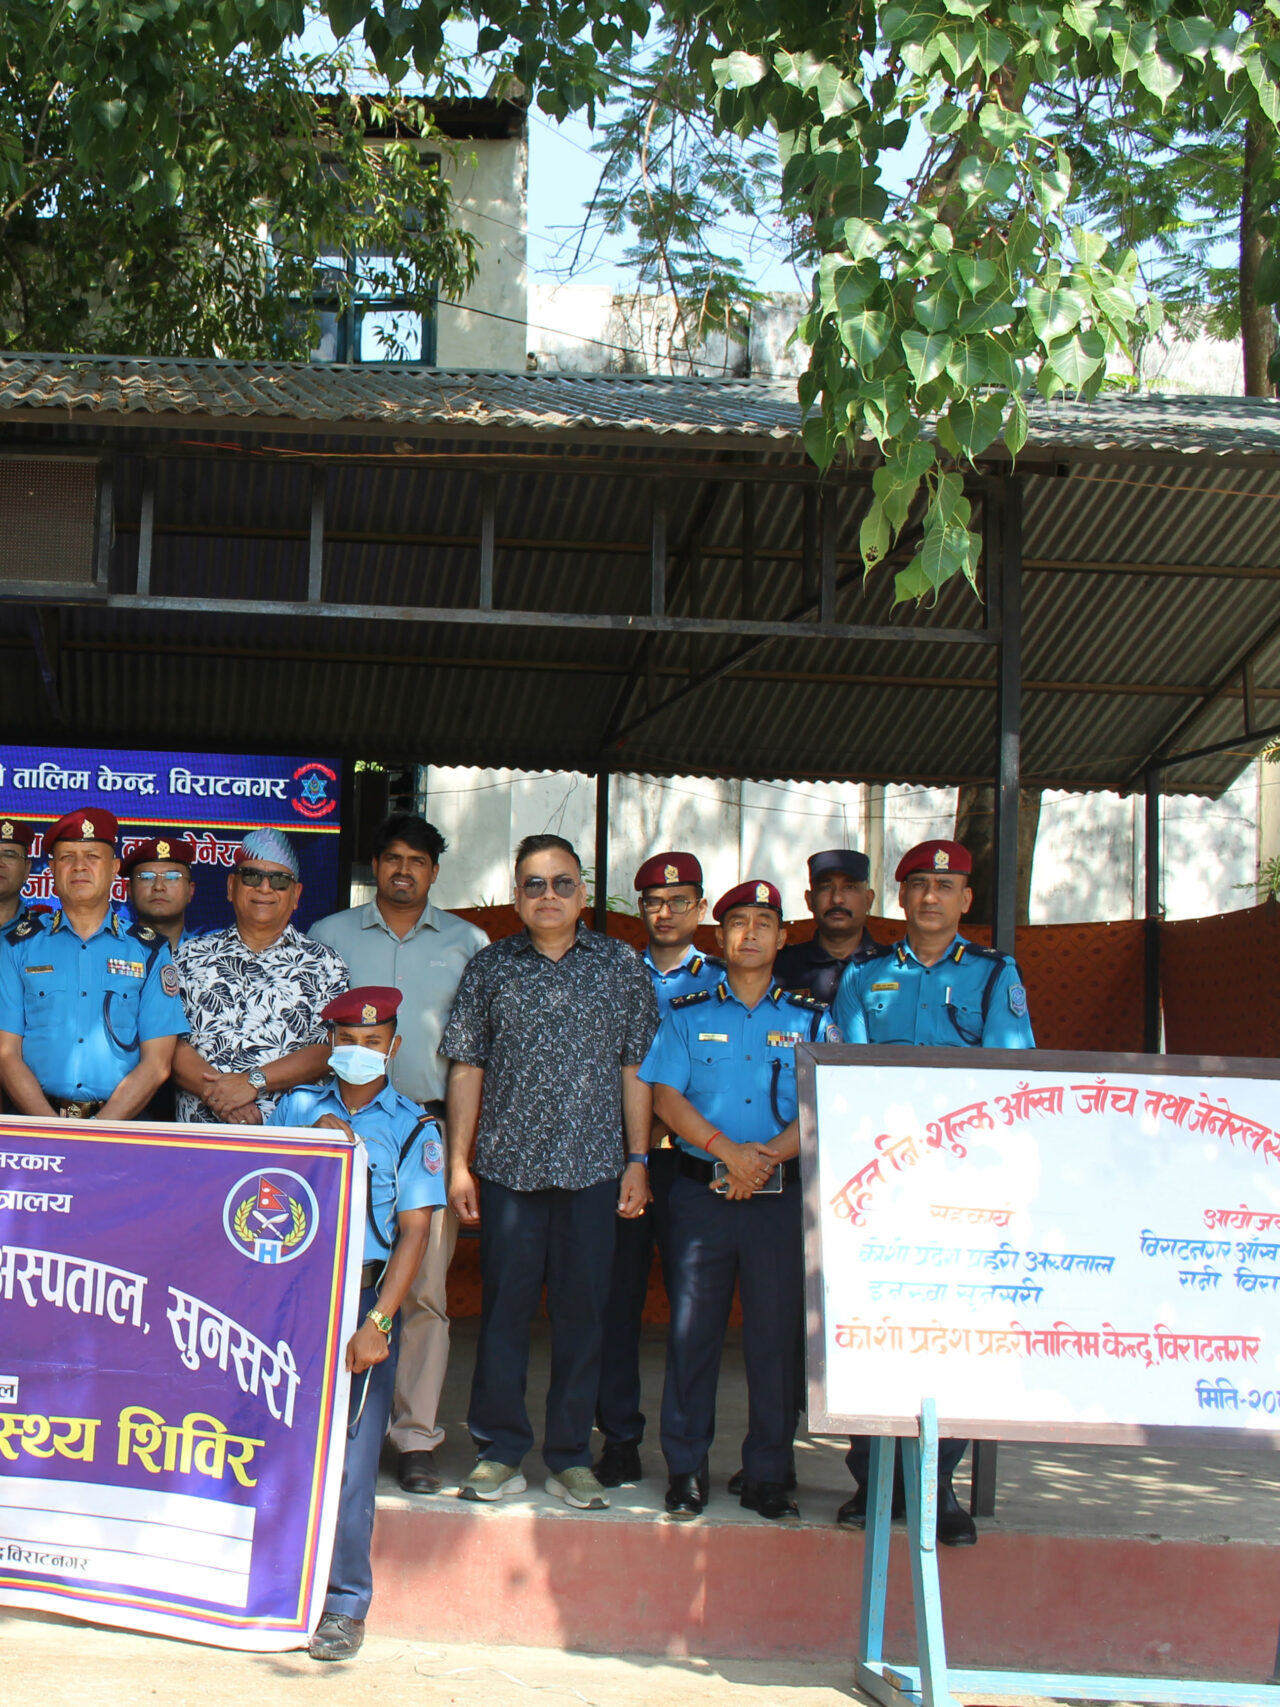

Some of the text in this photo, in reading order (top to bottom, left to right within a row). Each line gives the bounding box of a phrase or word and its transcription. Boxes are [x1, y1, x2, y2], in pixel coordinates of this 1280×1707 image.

[13, 762, 91, 791] तालिम
[169, 767, 290, 800] विराटनगर
[993, 1081, 1064, 1126] आँखा
[1070, 1076, 1139, 1118] जाँच
[1144, 1089, 1195, 1128] तथा
[1188, 1092, 1272, 1154] जेनेरल
[967, 1242, 1021, 1273] प्रहरी
[1139, 1229, 1231, 1262] विराटनगर
[1178, 1265, 1223, 1291] रानी
[166, 1285, 301, 1429] सुनसरी
[835, 1316, 903, 1351] कोशी
[908, 1320, 971, 1354] प्रदेश
[975, 1320, 1032, 1358] प्रहरी
[1032, 1321, 1100, 1359] तालिम
[1154, 1323, 1261, 1363] विराटनगर
[117, 1405, 266, 1488] शिविर
[6, 1544, 90, 1573] विराटनगर
